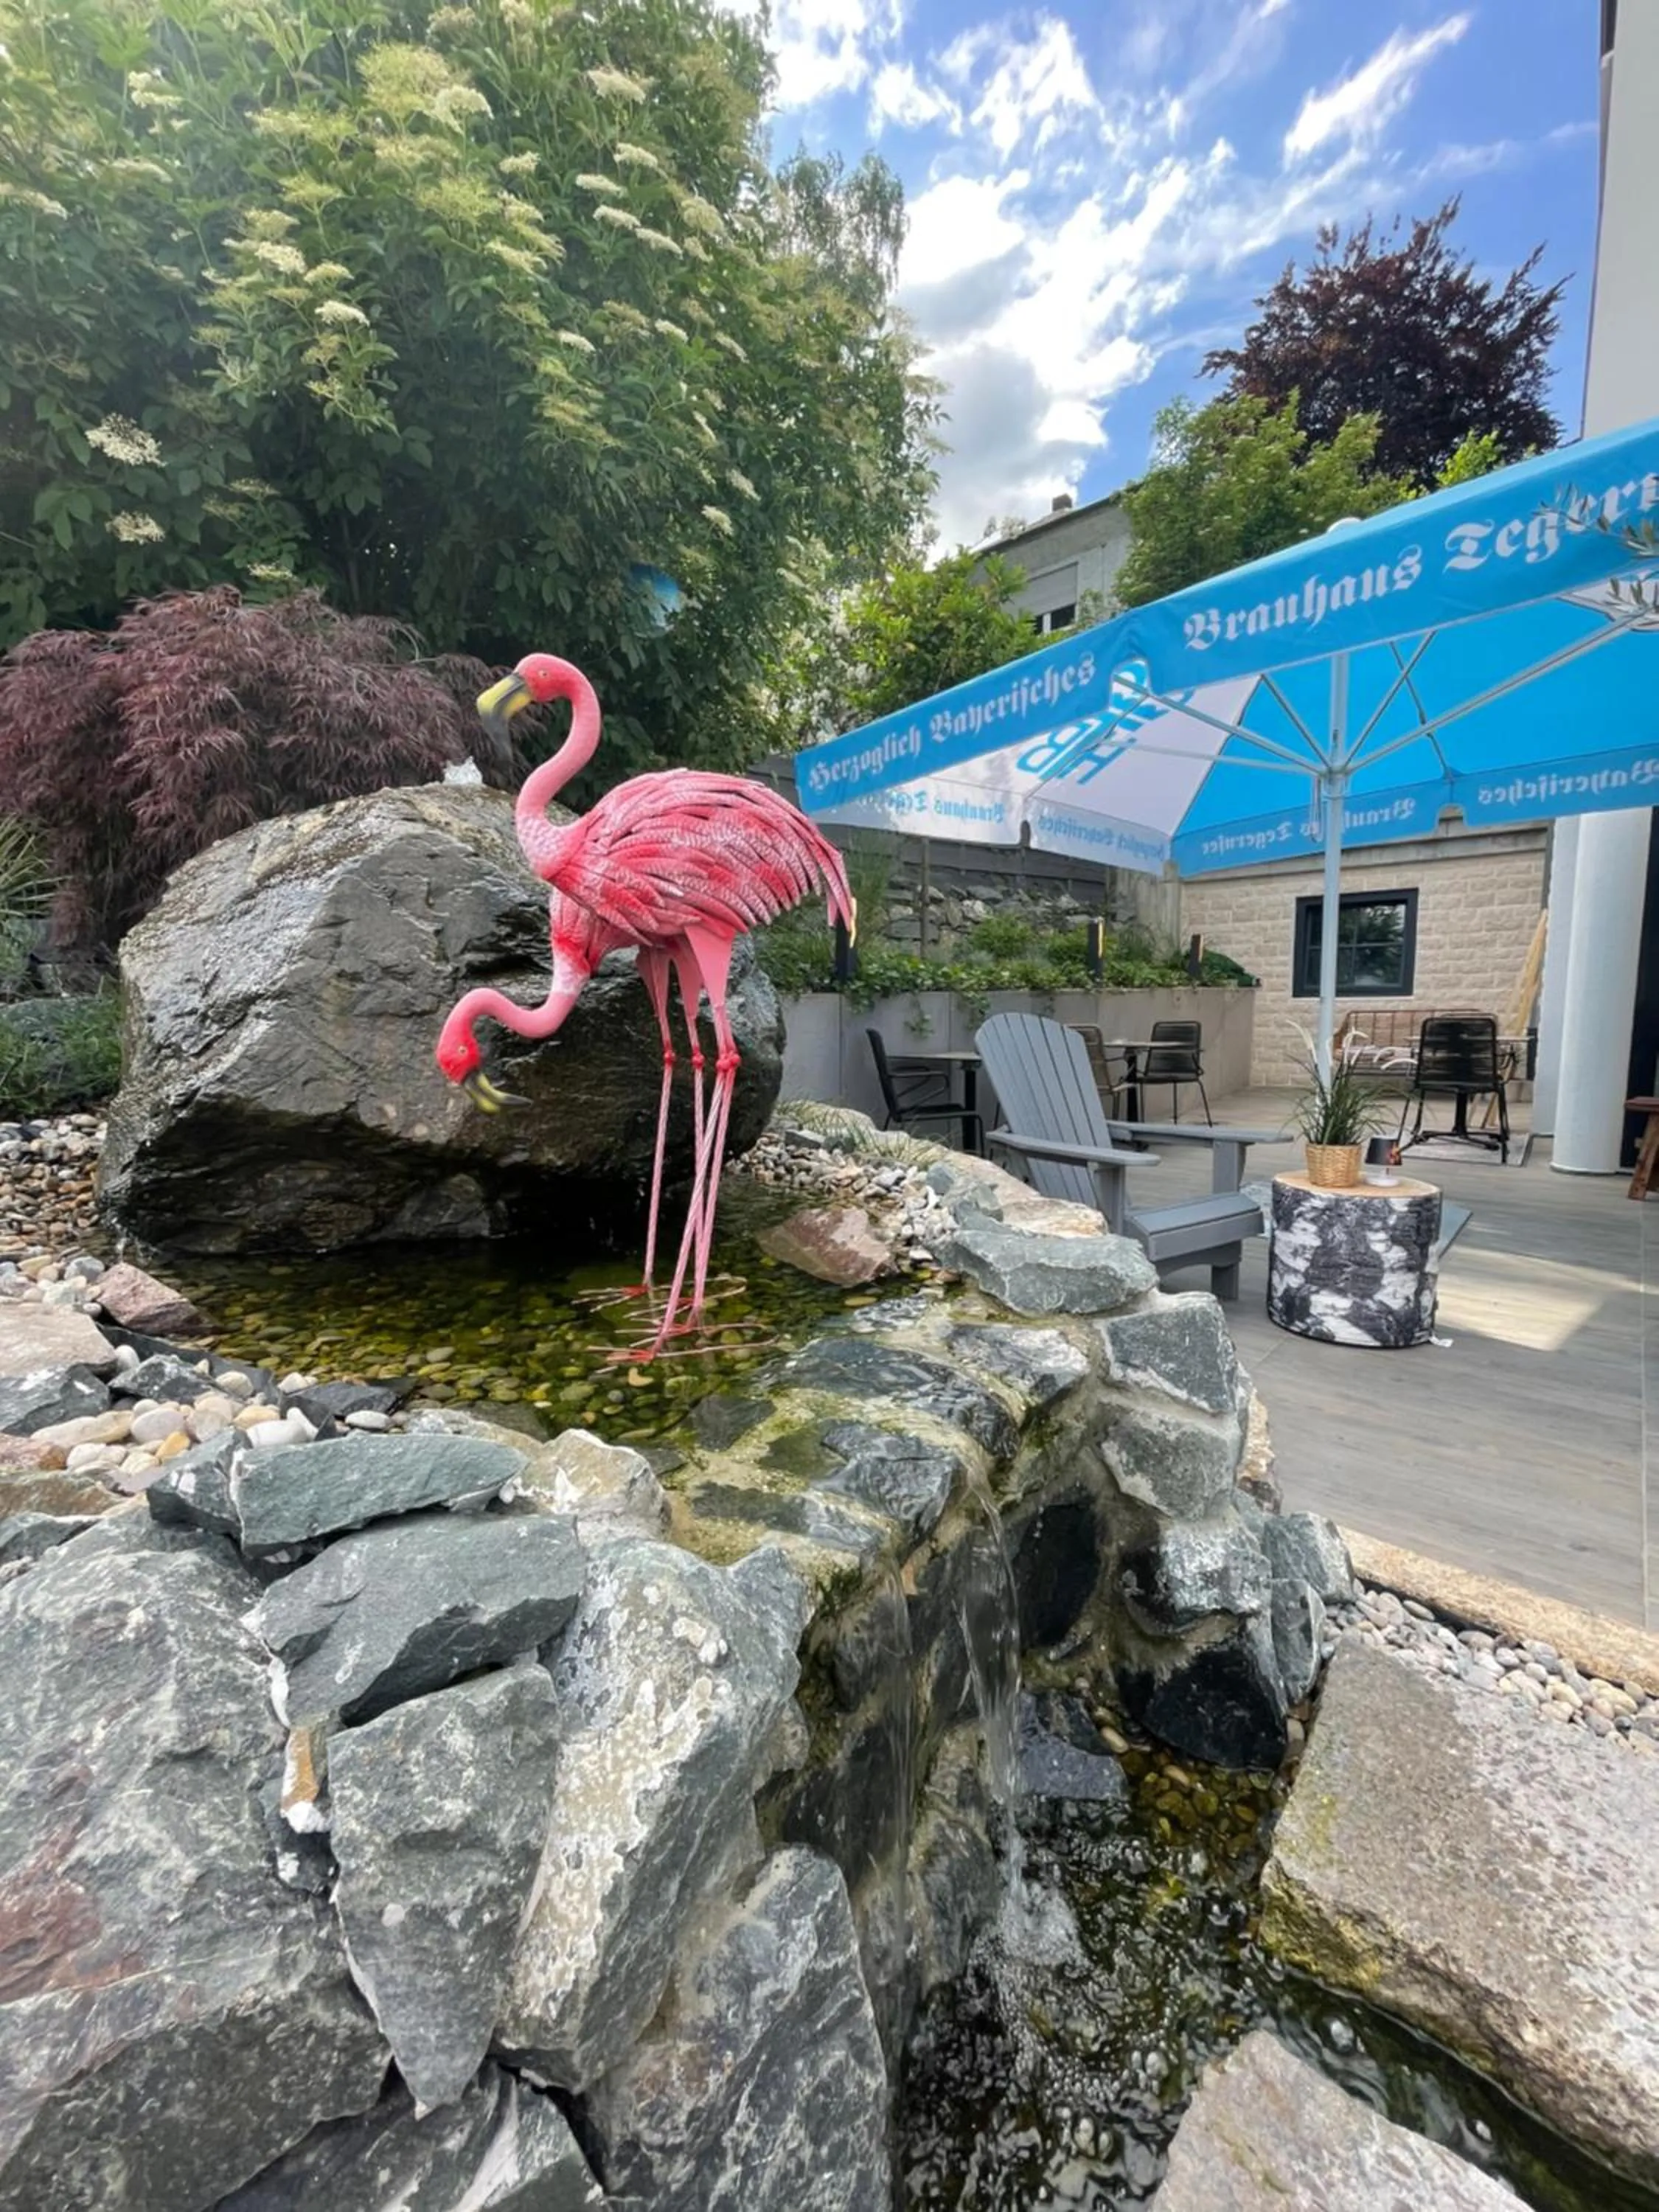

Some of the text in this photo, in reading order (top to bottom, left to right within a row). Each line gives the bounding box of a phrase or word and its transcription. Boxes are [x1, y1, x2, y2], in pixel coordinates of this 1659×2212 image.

[1183, 544, 1422, 650] Brauhaus
[808, 651, 1096, 790] Herzoglich Bayerisches
